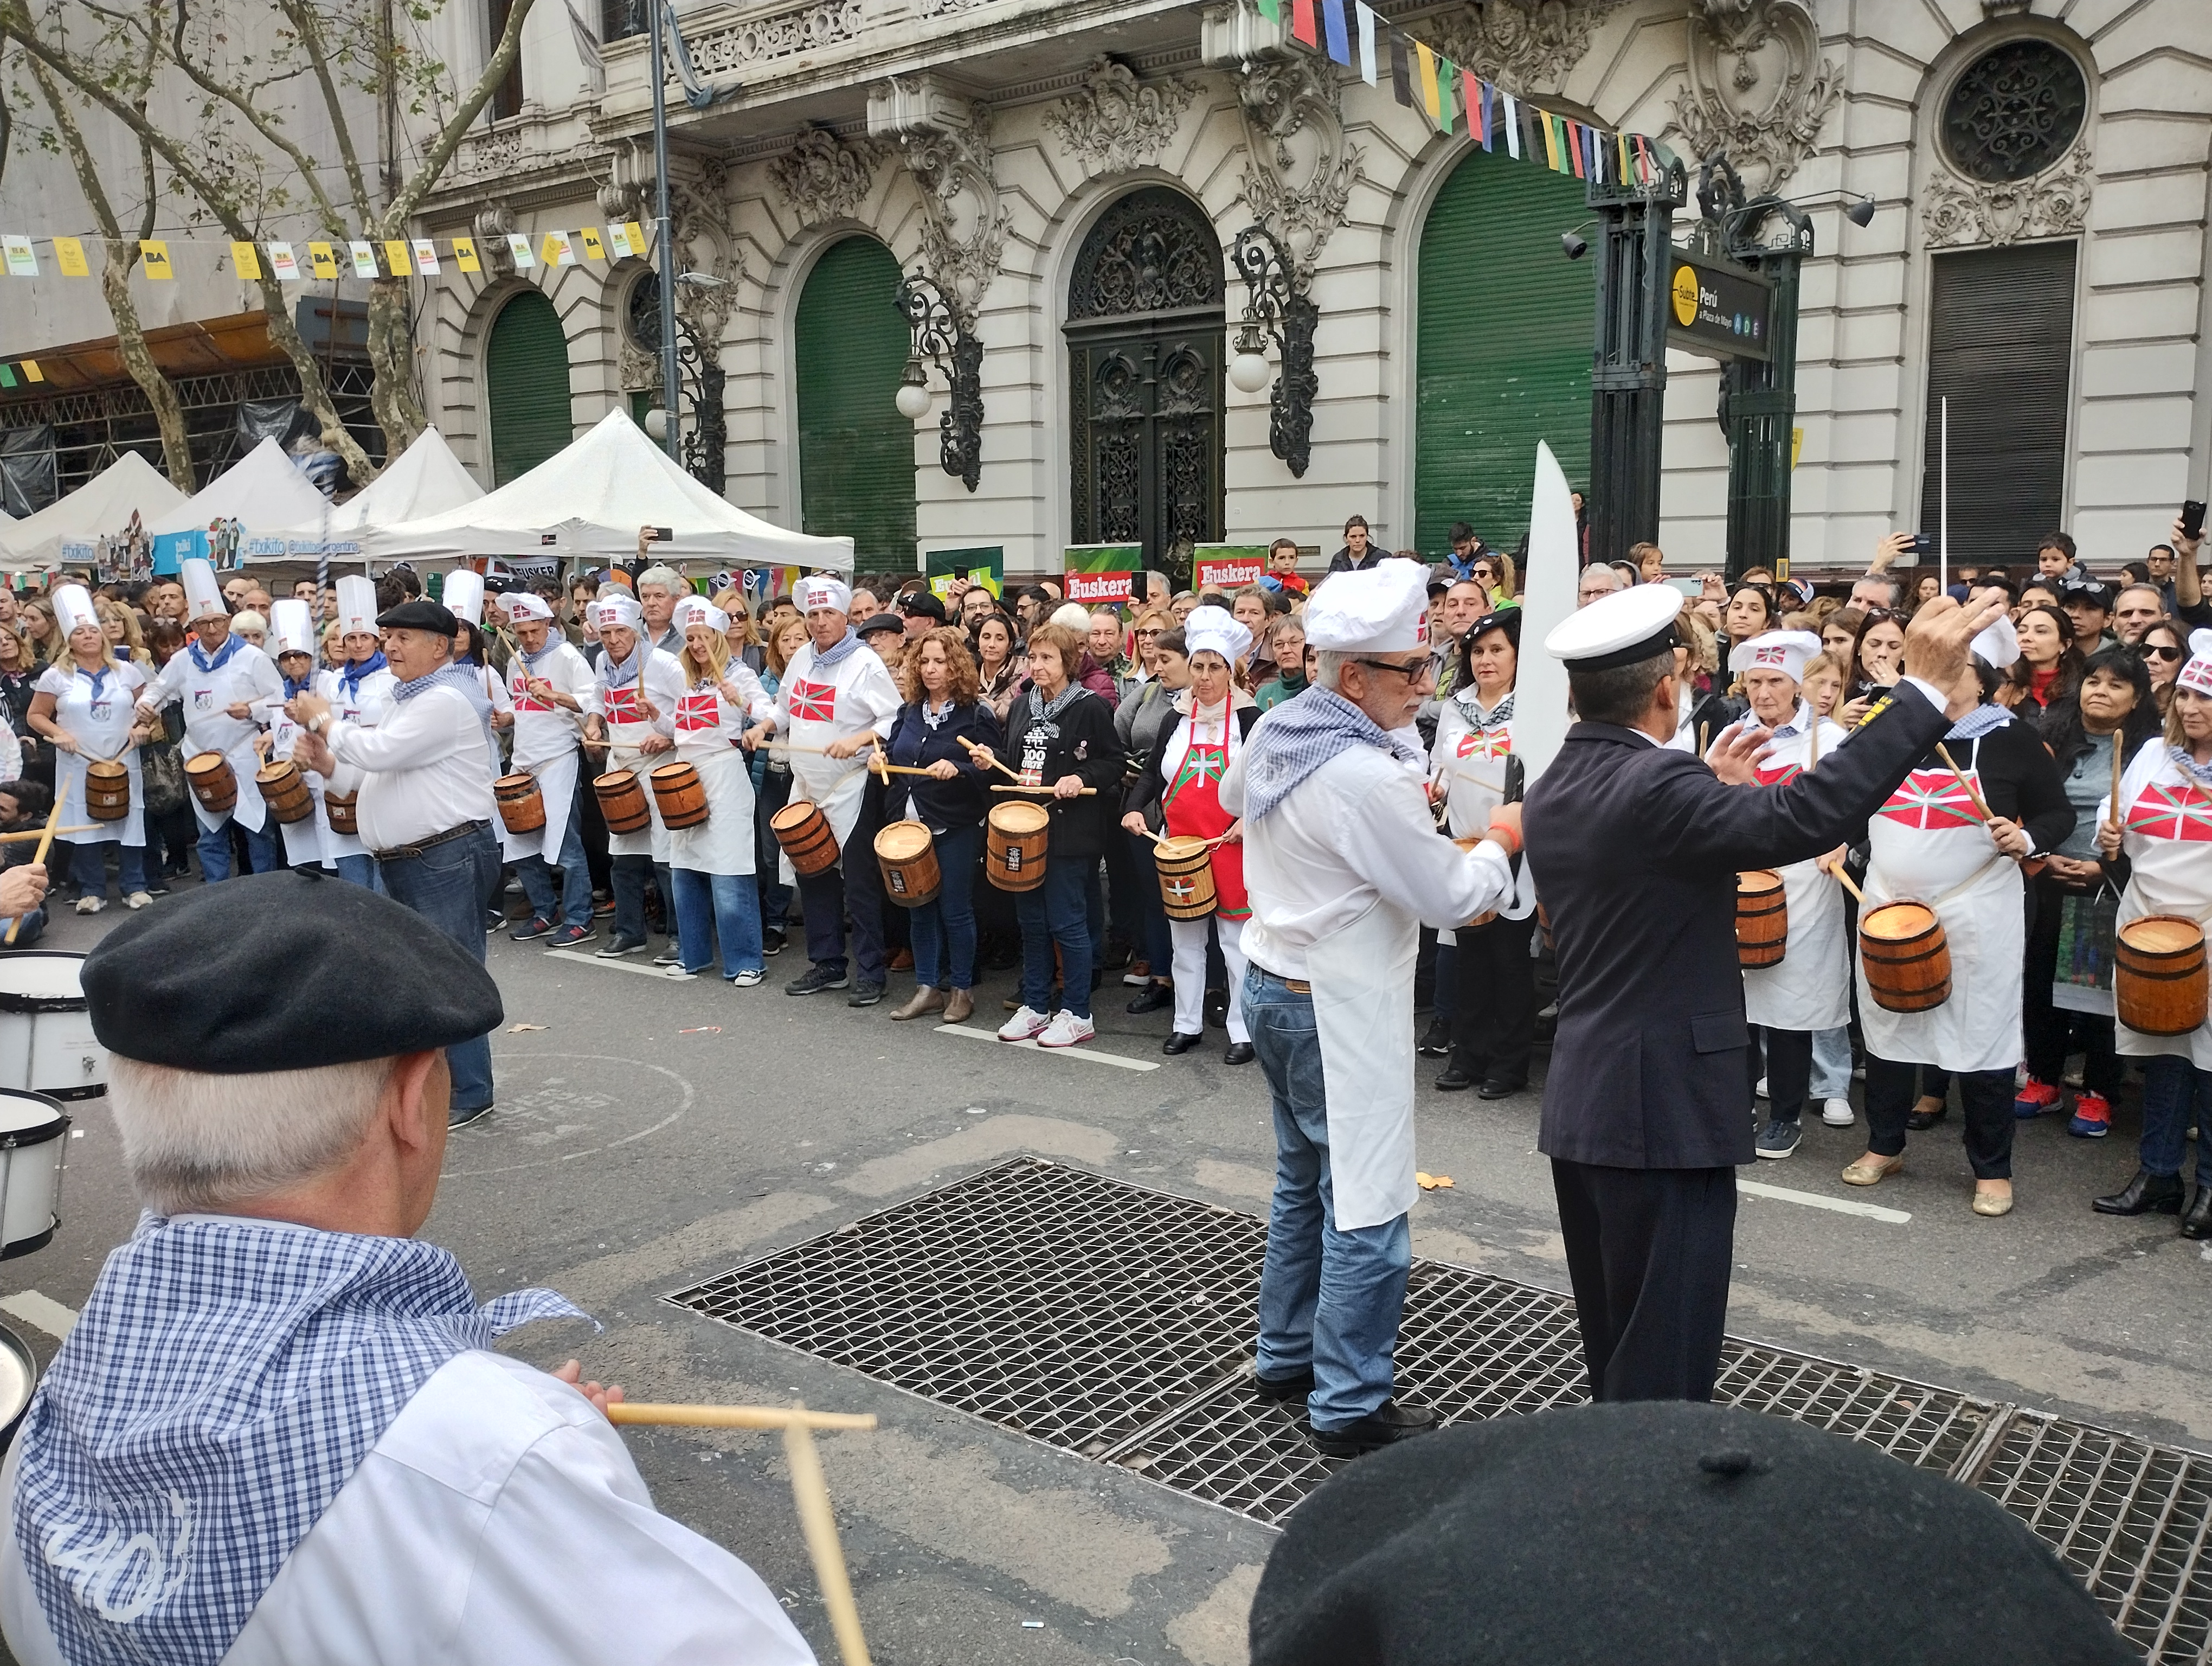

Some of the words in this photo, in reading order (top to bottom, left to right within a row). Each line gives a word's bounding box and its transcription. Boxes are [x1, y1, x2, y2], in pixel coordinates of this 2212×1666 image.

[145, 252, 166, 263] BA
[314, 254, 332, 263] BA
[1679, 285, 1695, 300] Subte
[1700, 286, 1718, 307] Perú
[1699, 311, 1702, 319] a
[1703, 310, 1714, 322] Plaza
[1714, 313, 1720, 324] de
[1720, 315, 1732, 329] Mayo
[1735, 317, 1740, 328] A
[1745, 320, 1749, 332] D
[1754, 322, 1759, 335] E
[249, 538, 284, 553] #txikito
[516, 566, 556, 580] EUSKER
[1201, 564, 1261, 585] Euskera
[1069, 576, 1132, 599] Euskera
[1023, 749, 1046, 761] 100
[1021, 760, 1044, 770] URTE
